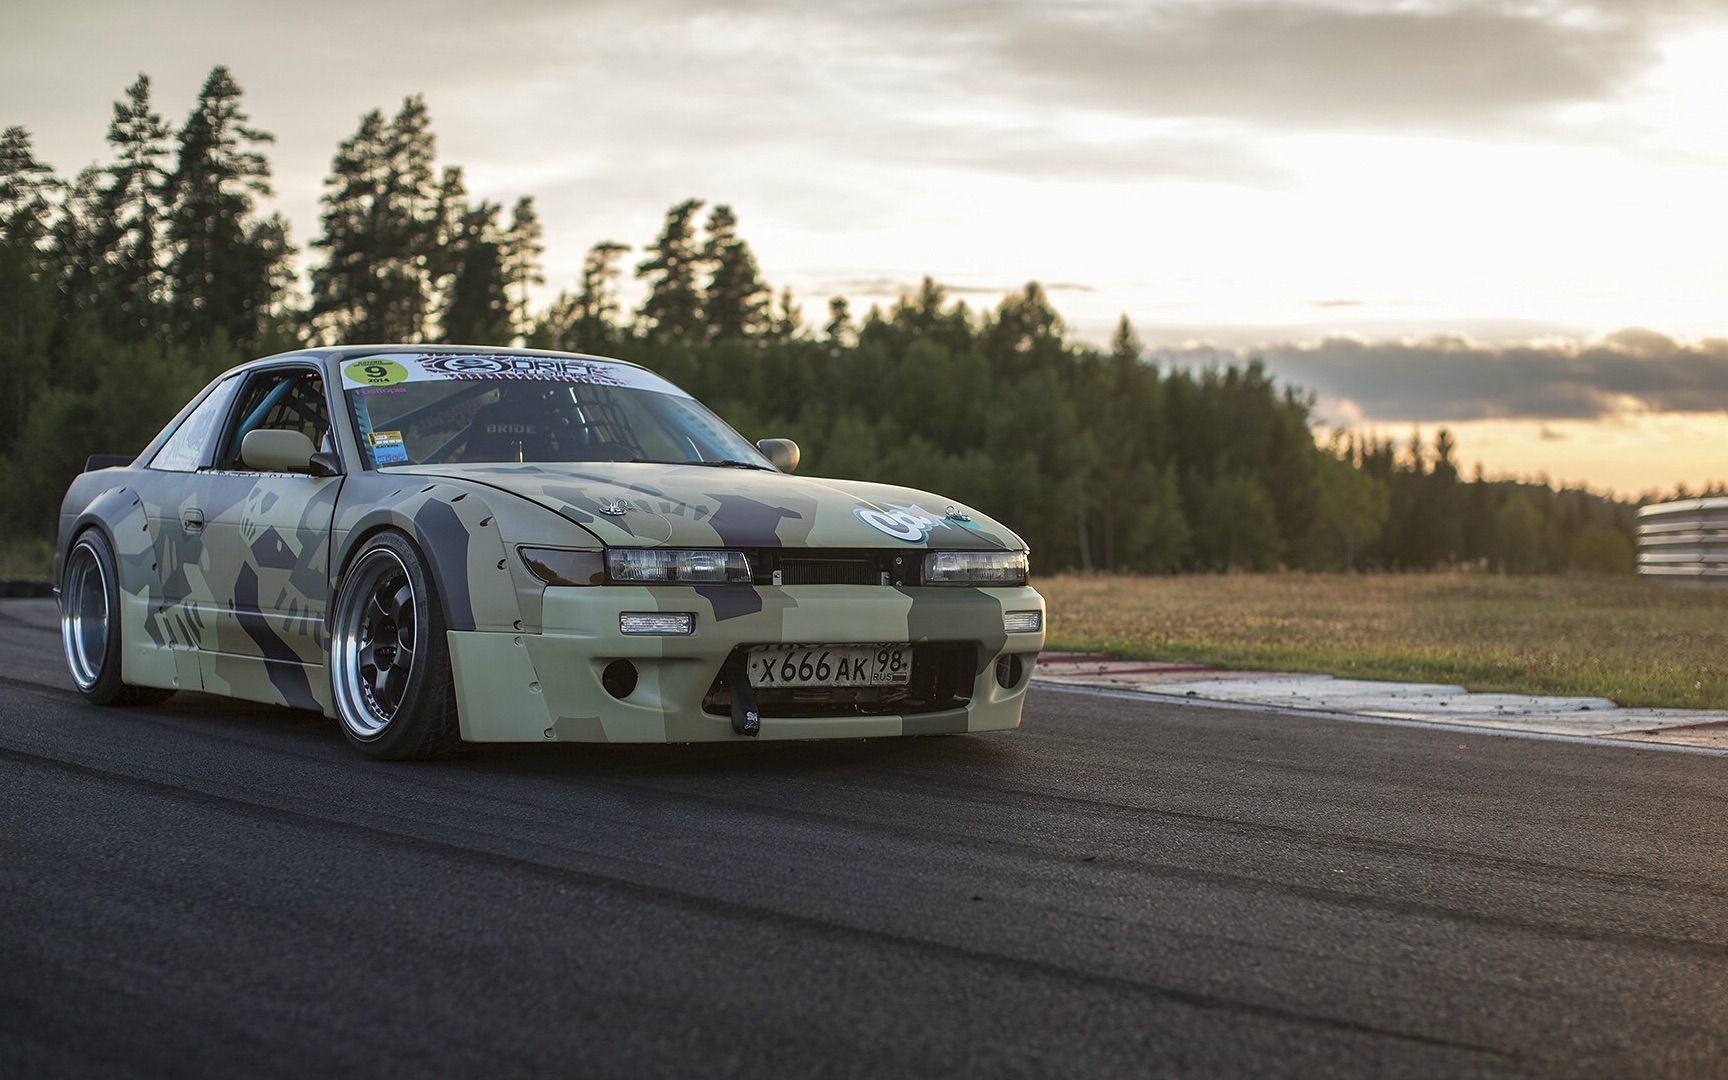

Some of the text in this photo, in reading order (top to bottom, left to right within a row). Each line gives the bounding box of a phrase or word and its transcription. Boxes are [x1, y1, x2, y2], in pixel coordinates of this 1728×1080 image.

[364, 365, 387, 378] 9
[486, 424, 537, 434] BRIDE
[877, 651, 902, 672] 98
[873, 672, 892, 681] RUS
